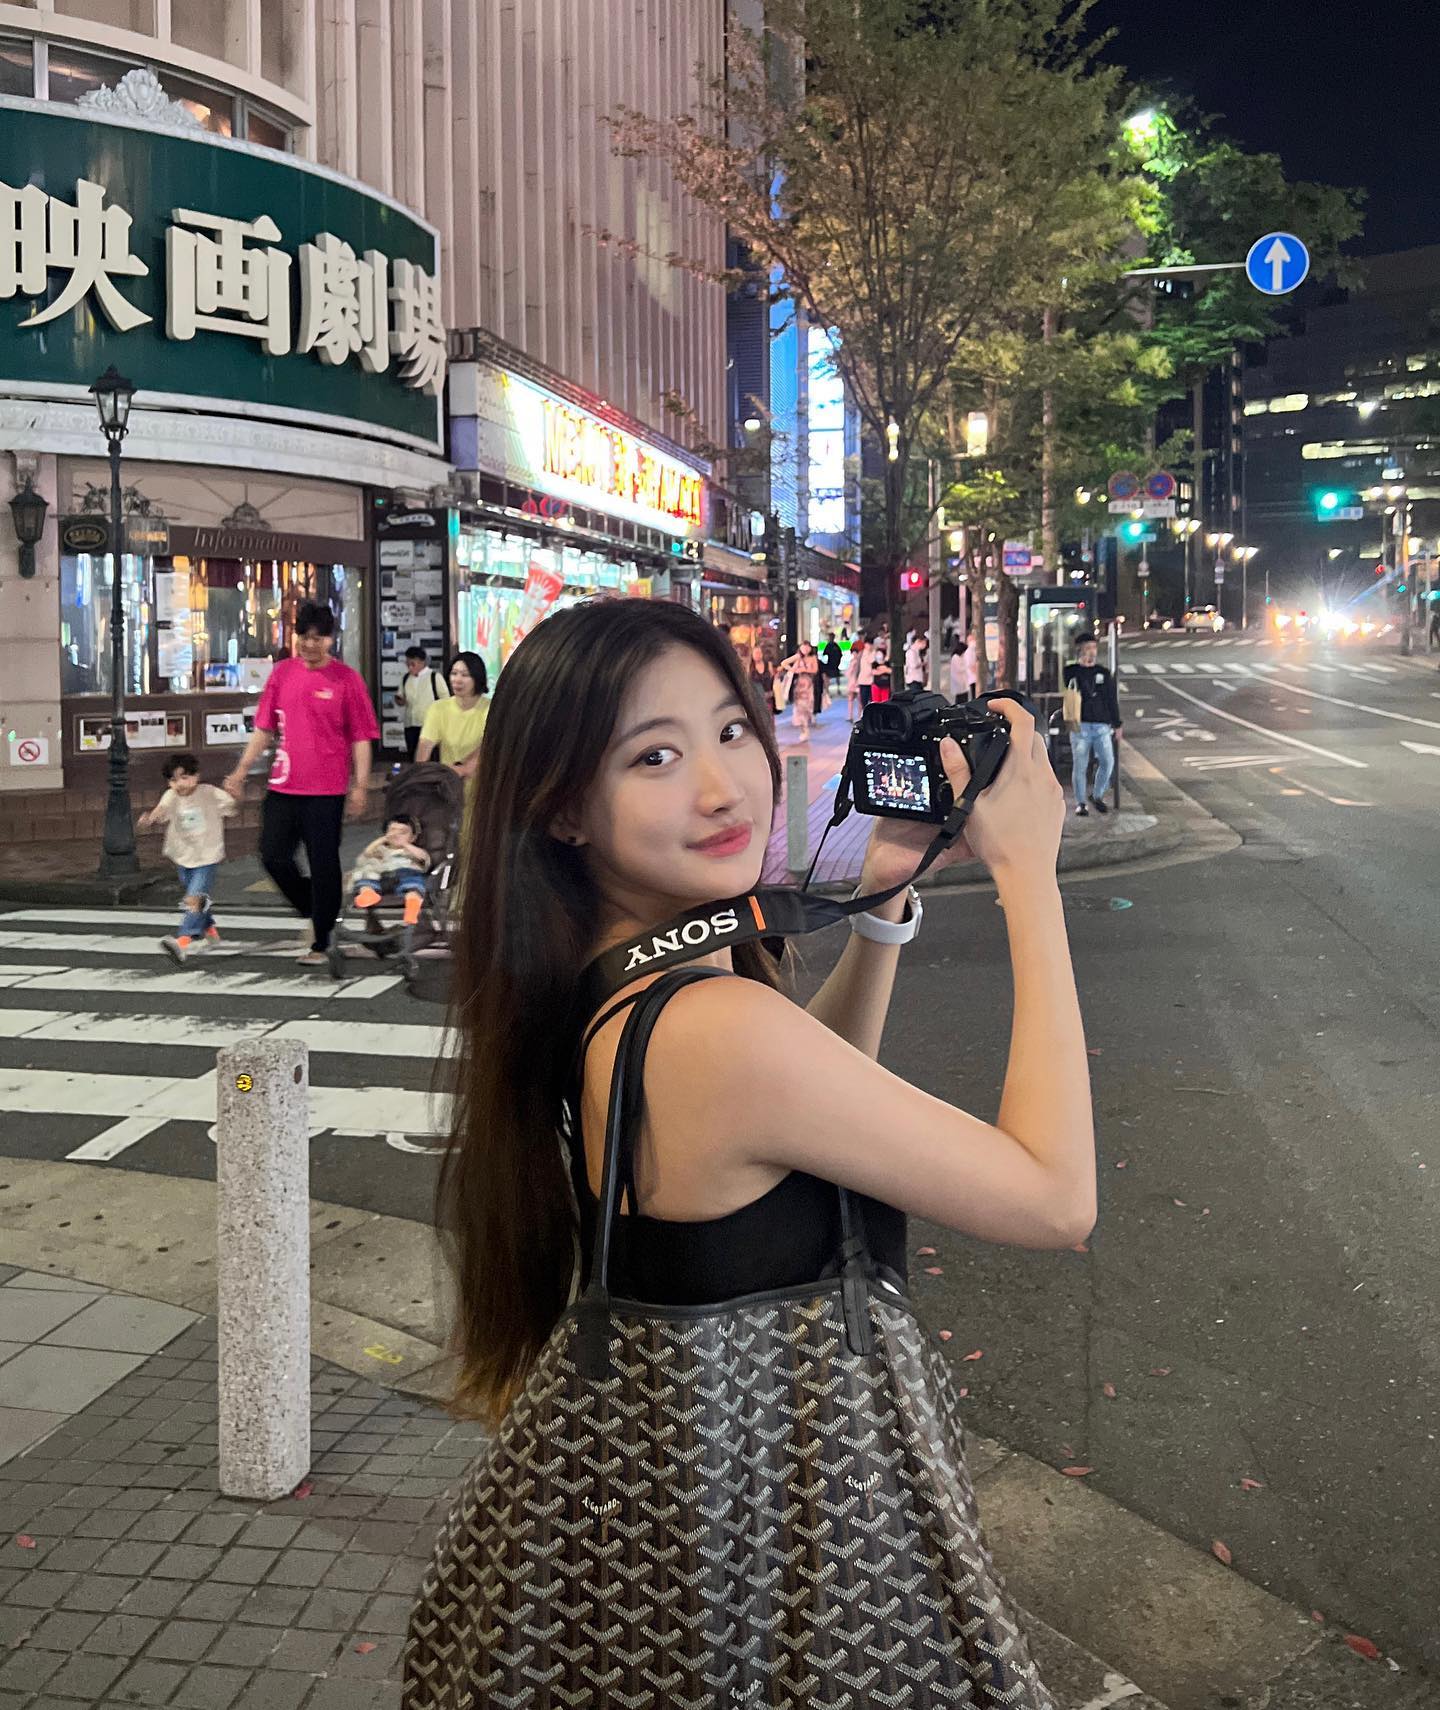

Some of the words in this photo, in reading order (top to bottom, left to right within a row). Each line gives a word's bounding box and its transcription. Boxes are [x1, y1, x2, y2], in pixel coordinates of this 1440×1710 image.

[0, 178, 446, 396] 映画劇場
[195, 527, 303, 553] Information
[624, 908, 739, 971] SONY
